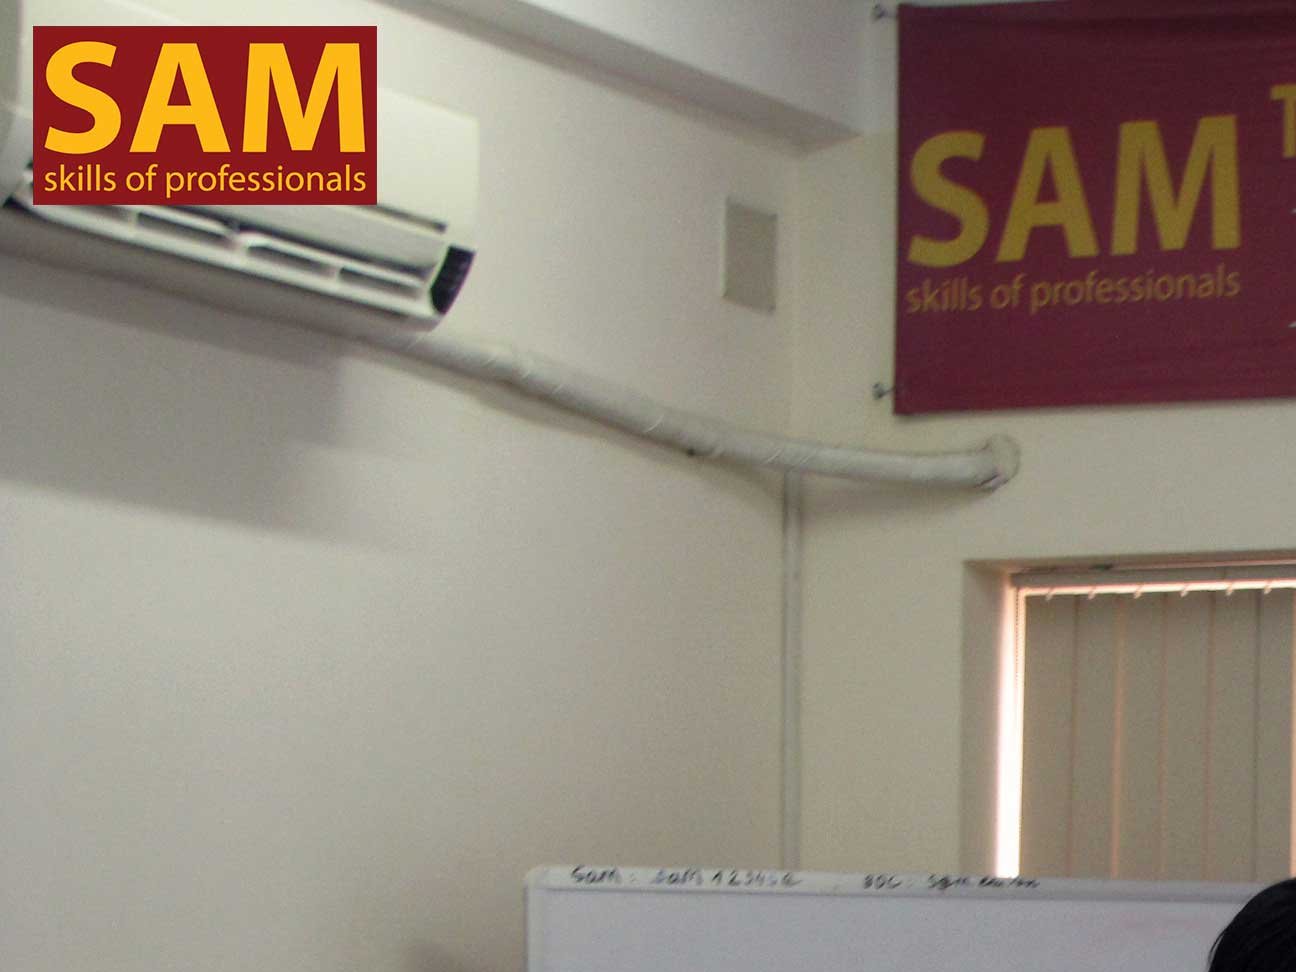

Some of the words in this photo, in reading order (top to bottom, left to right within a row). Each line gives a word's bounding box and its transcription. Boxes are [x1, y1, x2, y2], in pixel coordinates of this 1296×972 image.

[907, 114, 1242, 268] SAM
[906, 278, 982, 313] skills
[990, 273, 1026, 310] of
[1030, 263, 1240, 314] professionals
